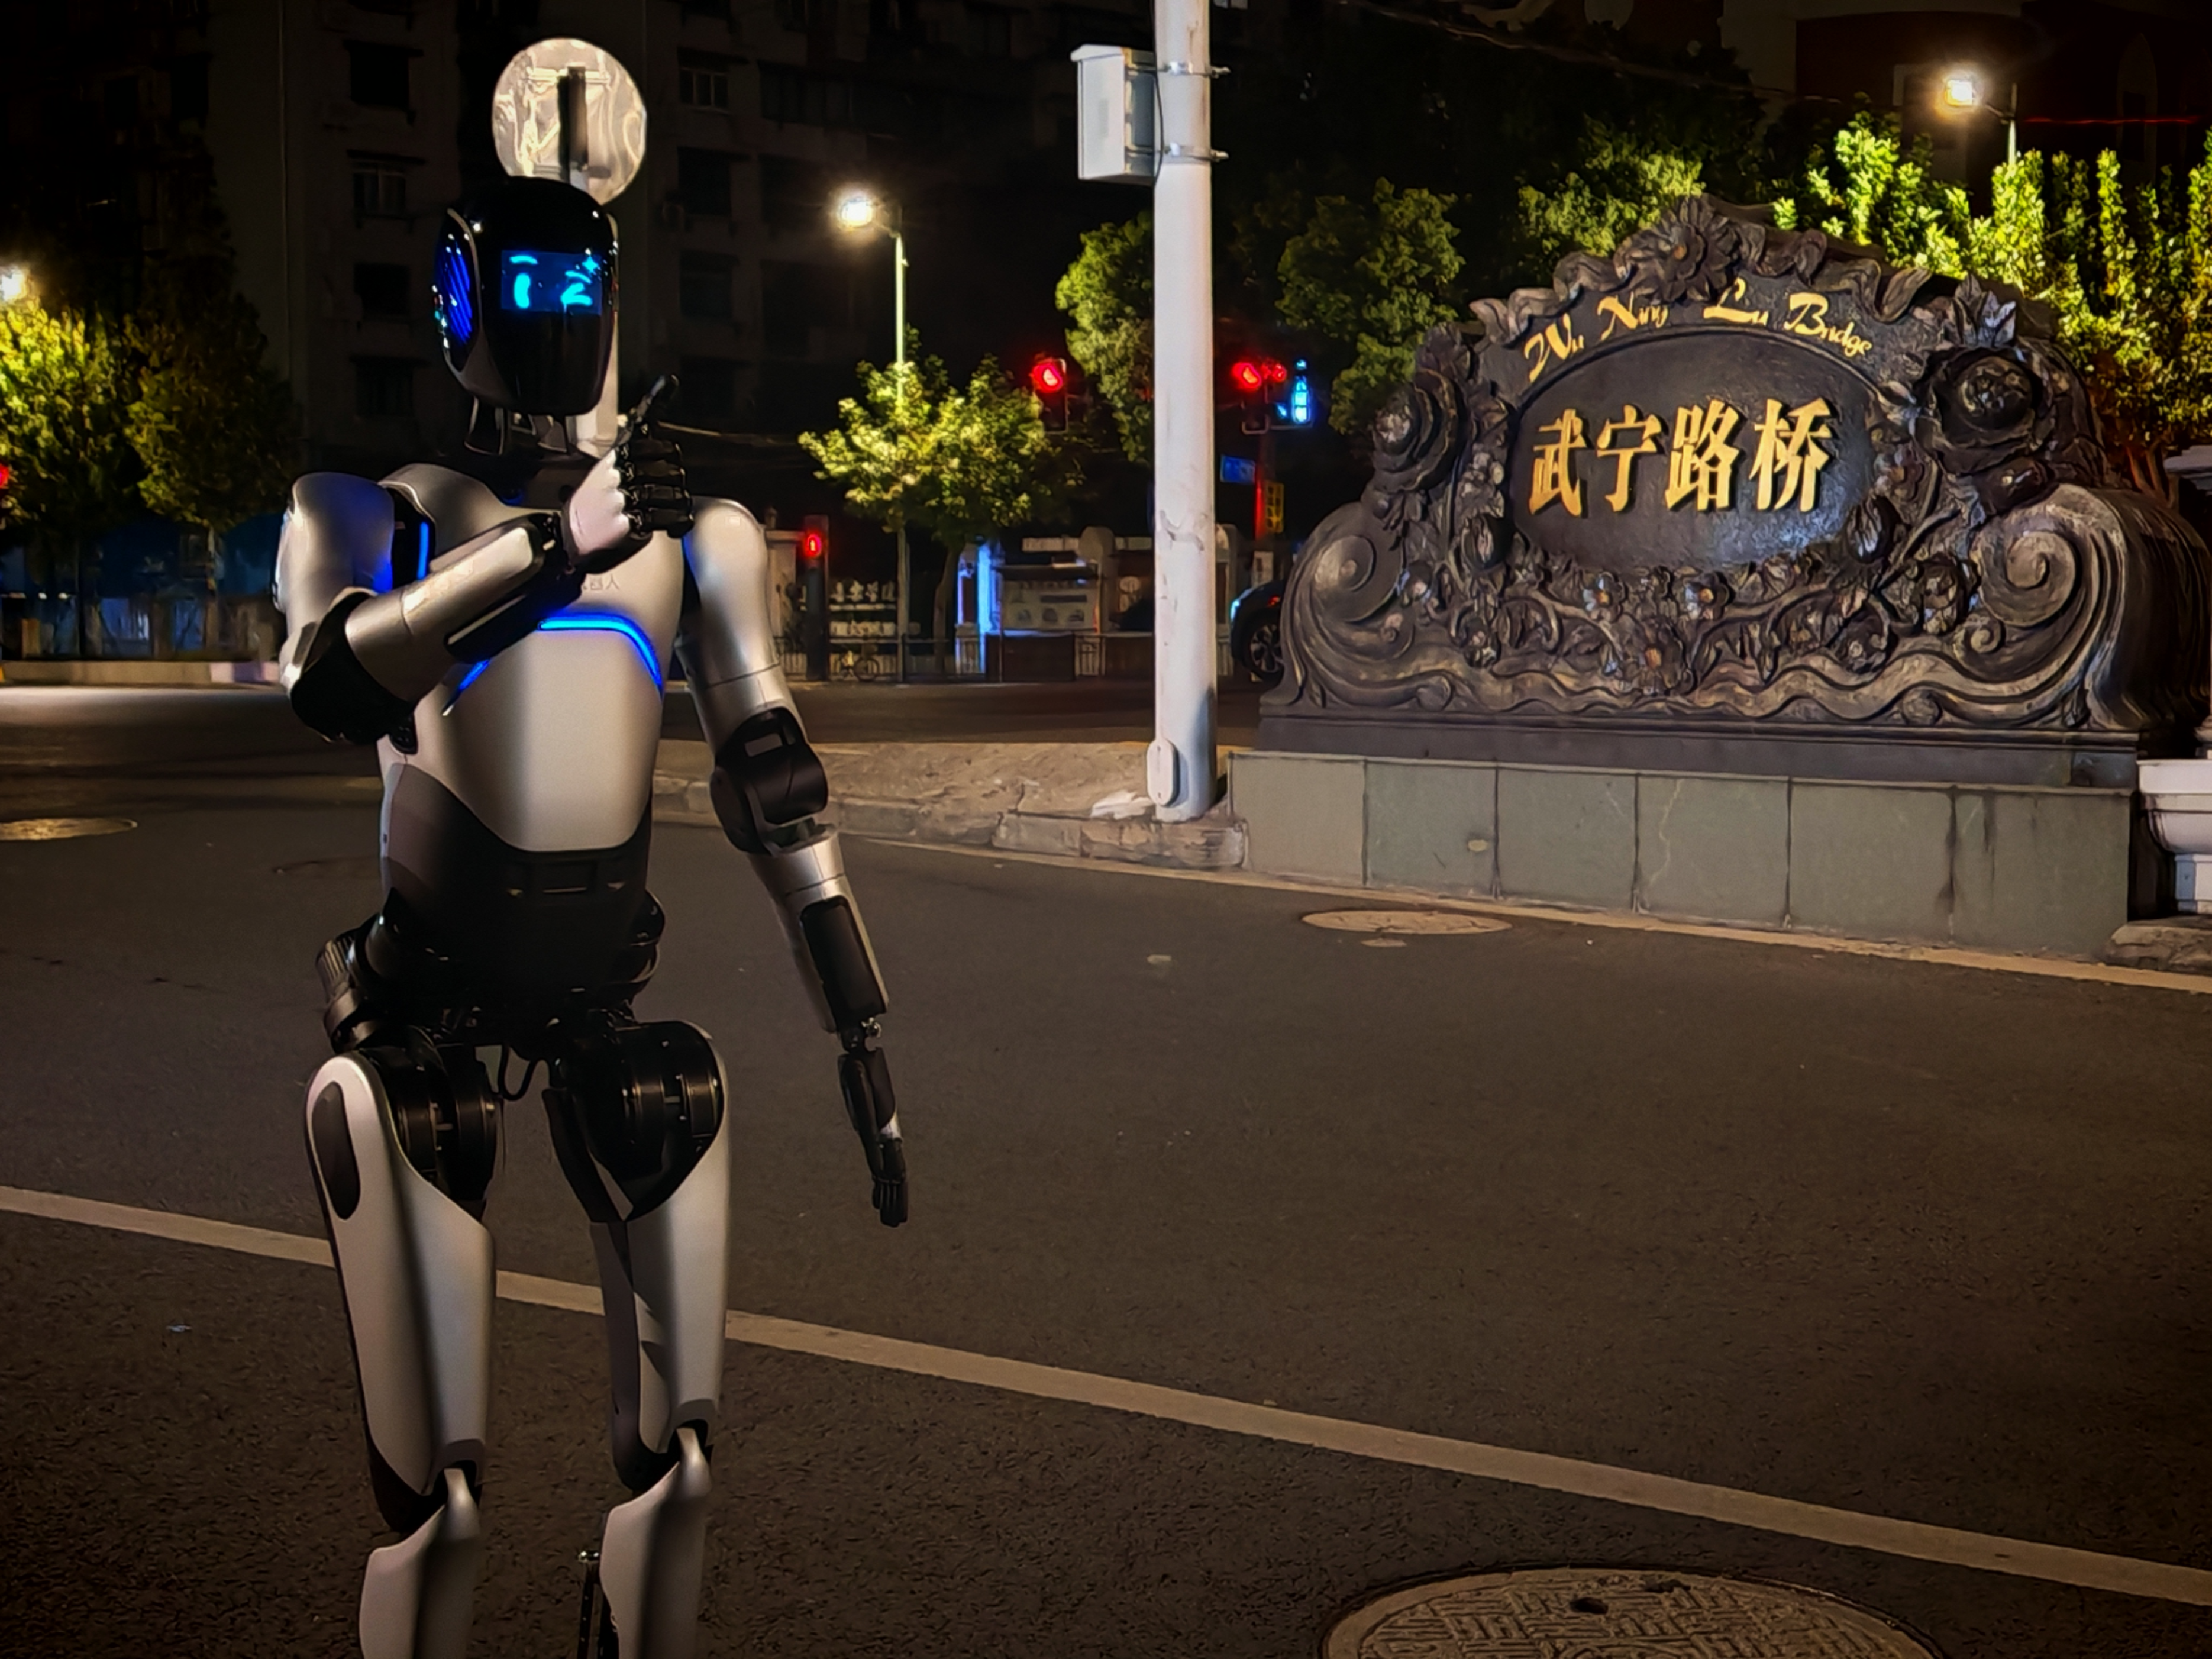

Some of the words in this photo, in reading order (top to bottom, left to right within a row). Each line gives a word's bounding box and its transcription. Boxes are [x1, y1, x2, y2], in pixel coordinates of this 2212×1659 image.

[1524, 313, 1584, 383] Wu
[1703, 277, 1769, 326] Lu
[1783, 292, 1872, 356] Bridge
[1529, 398, 1832, 516] 武宁路桥
